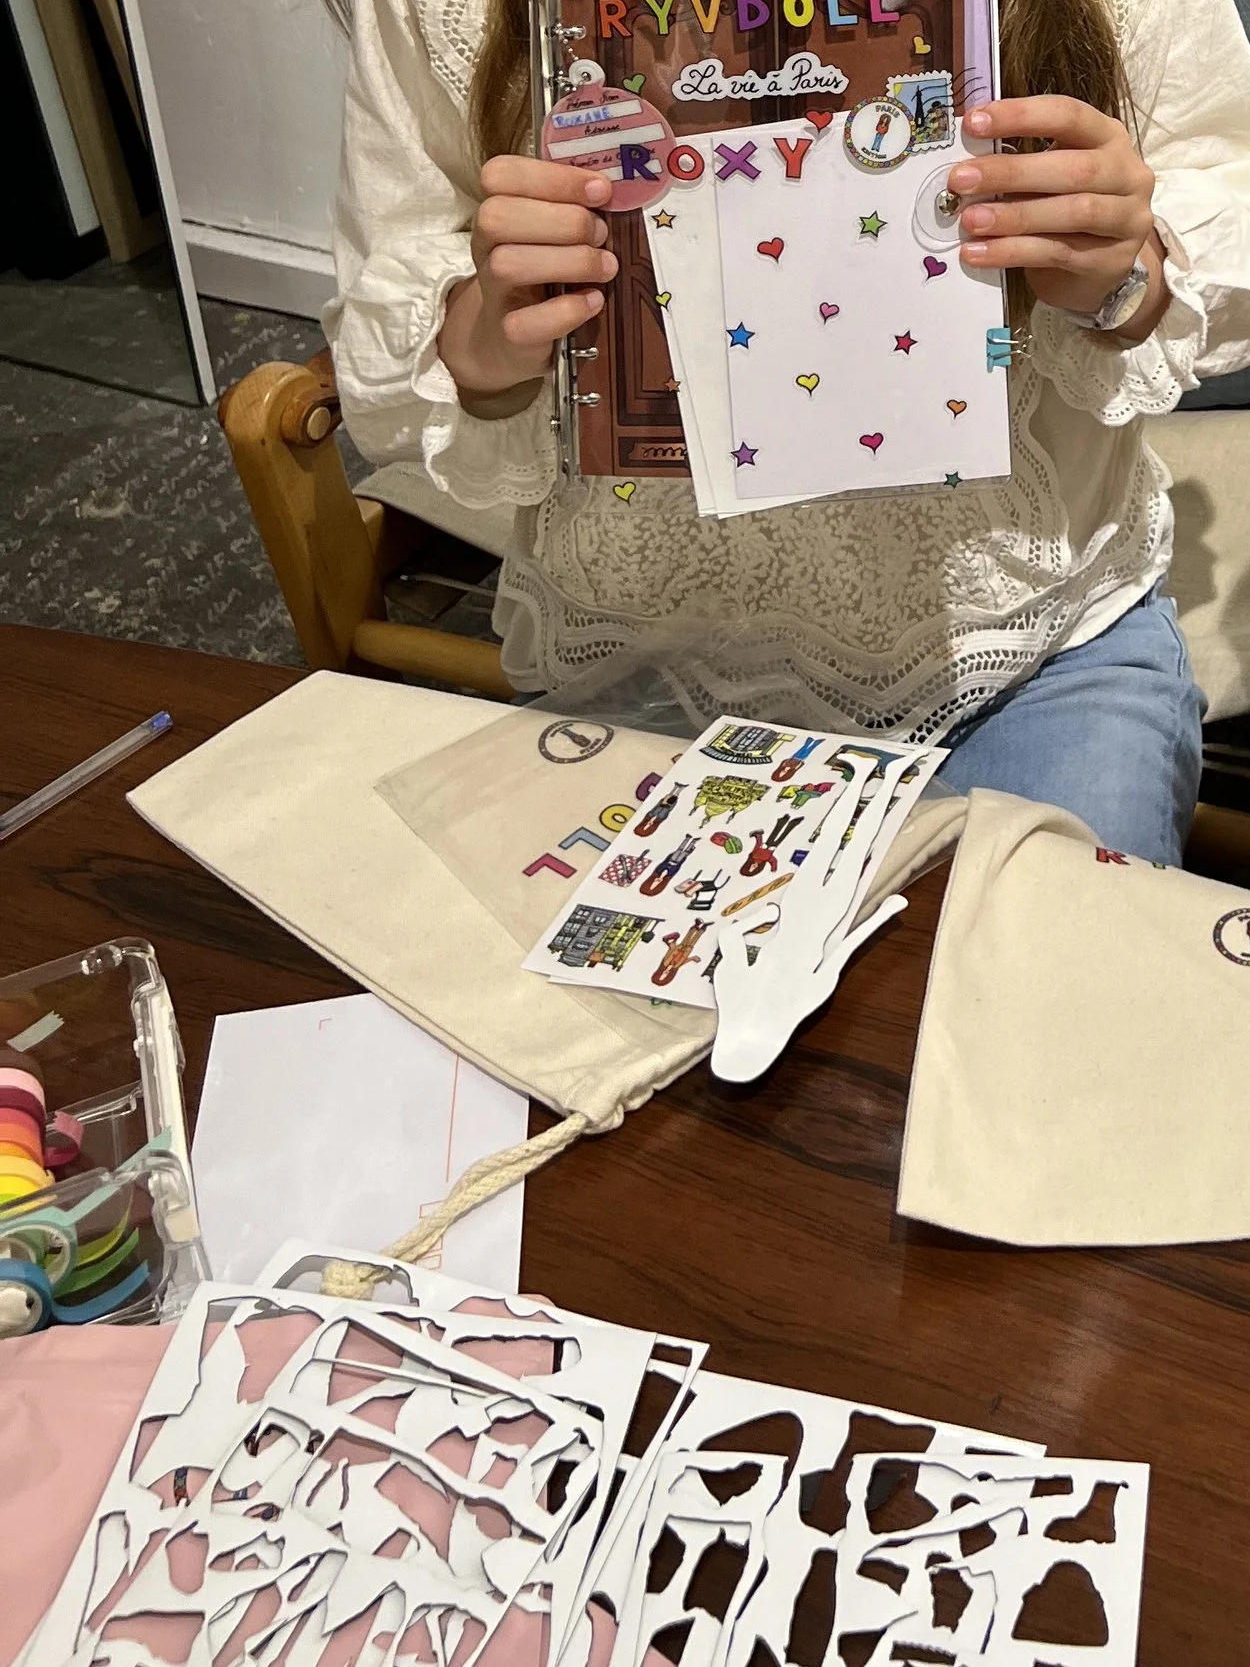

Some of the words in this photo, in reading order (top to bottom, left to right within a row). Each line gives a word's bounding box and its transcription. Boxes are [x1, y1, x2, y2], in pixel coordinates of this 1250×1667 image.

[681, 64, 722, 95] La
[731, 75, 760, 95] vie
[789, 57, 844, 91] Paris
[875, 104, 901, 119] PARIS
[619, 137, 813, 183] ROXY
